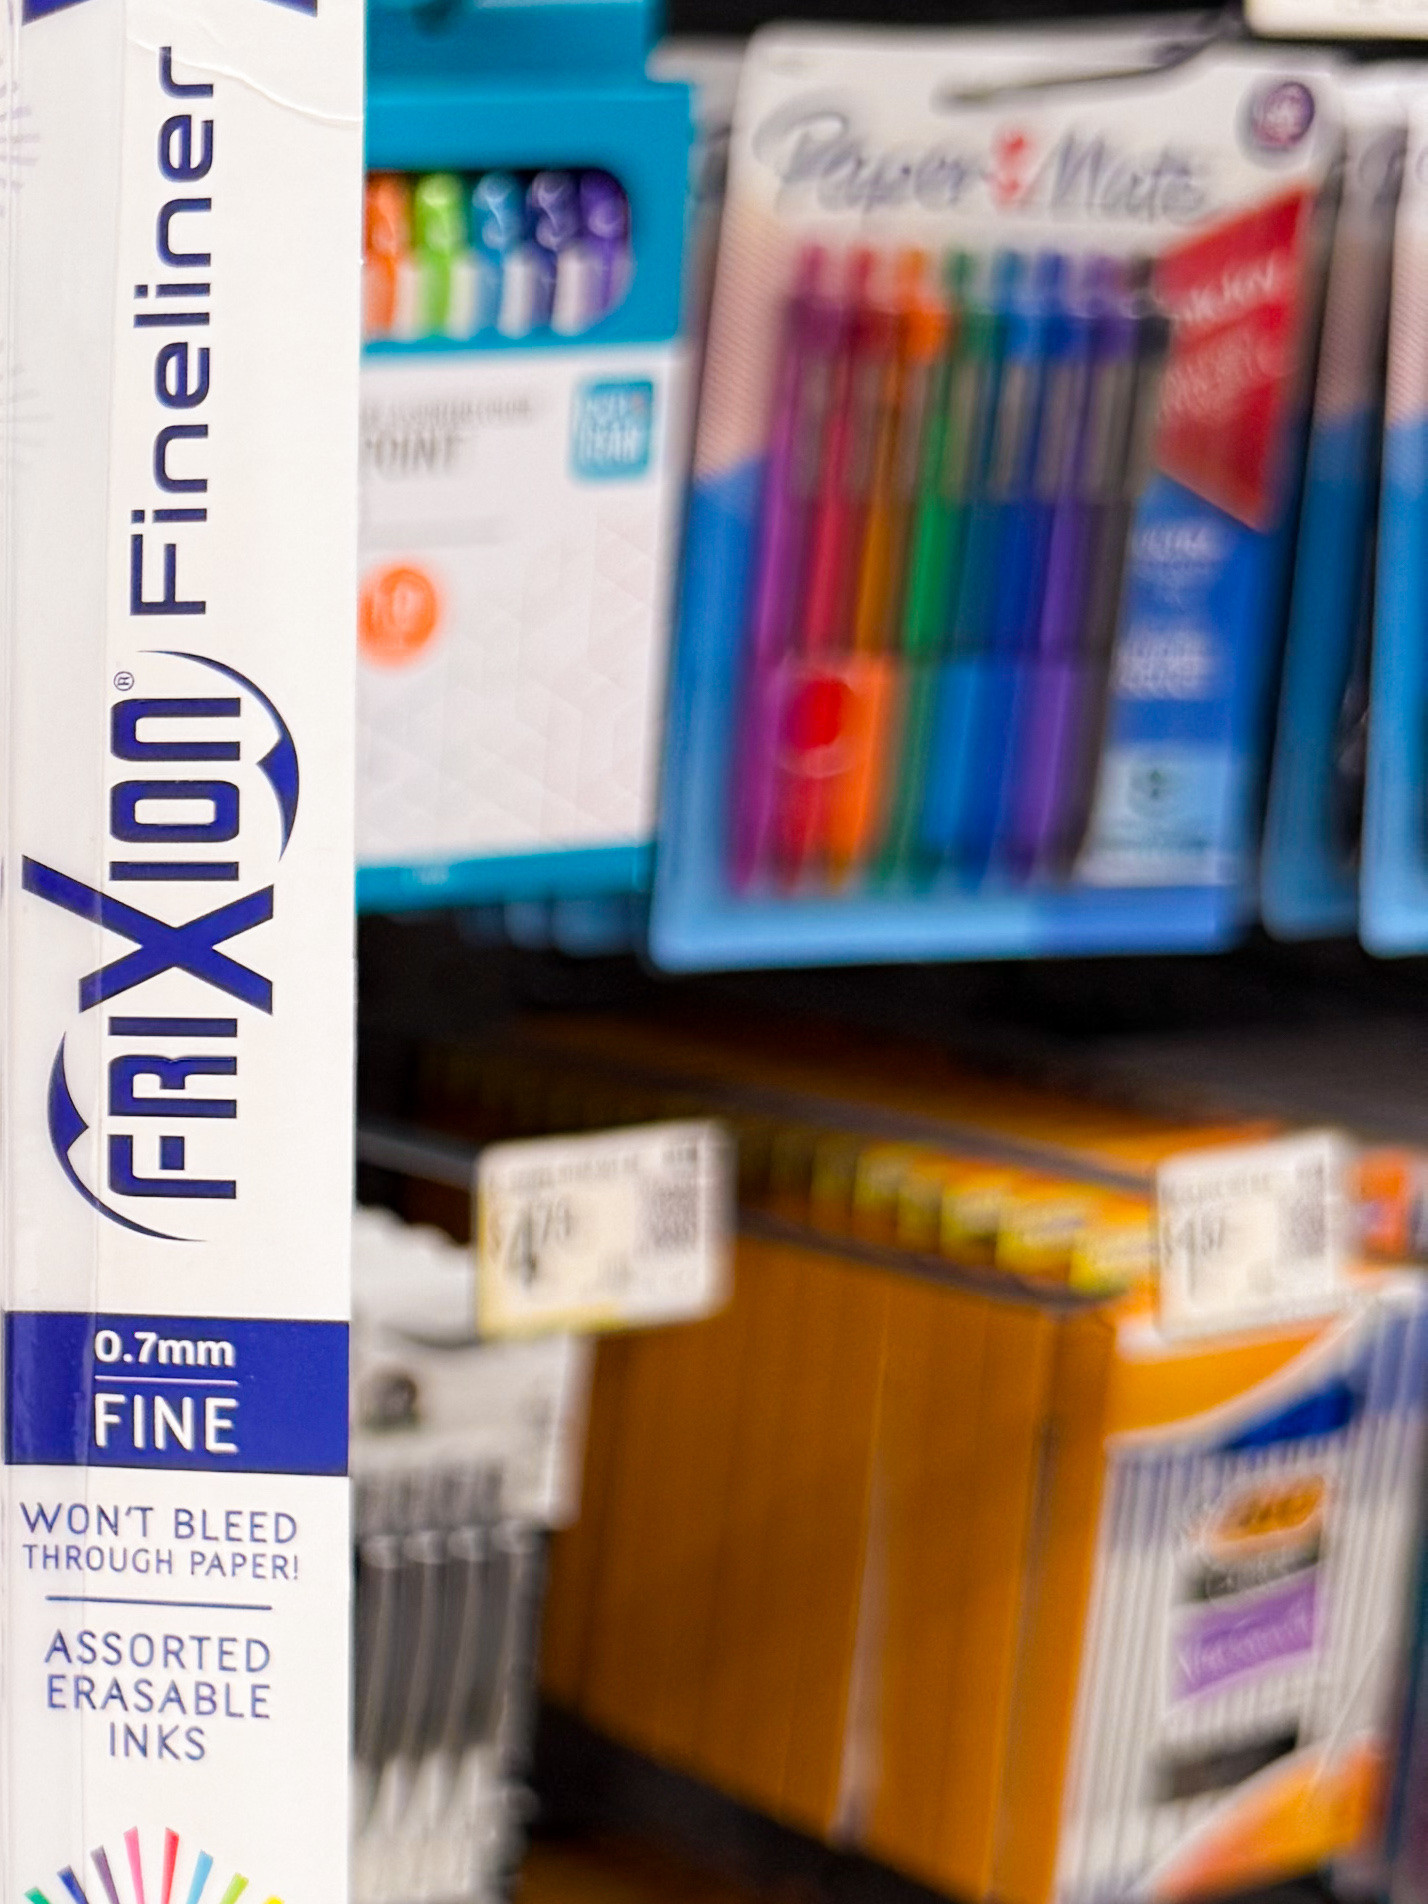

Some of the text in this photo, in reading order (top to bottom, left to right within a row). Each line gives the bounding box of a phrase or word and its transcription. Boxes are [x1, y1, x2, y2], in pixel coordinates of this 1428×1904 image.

[129, 45, 215, 617] Fineliner
[94, 1329, 237, 1368] 0.7mm
[93, 1392, 241, 1455] FINE
[18, 1500, 299, 1546] WON'T BLEED
[23, 1543, 301, 1582] THROUGH PAPER!
[44, 1628, 272, 1674] ASSORTED
[47, 1673, 272, 1721] ERASABLE
[108, 1720, 207, 1763] INKS
